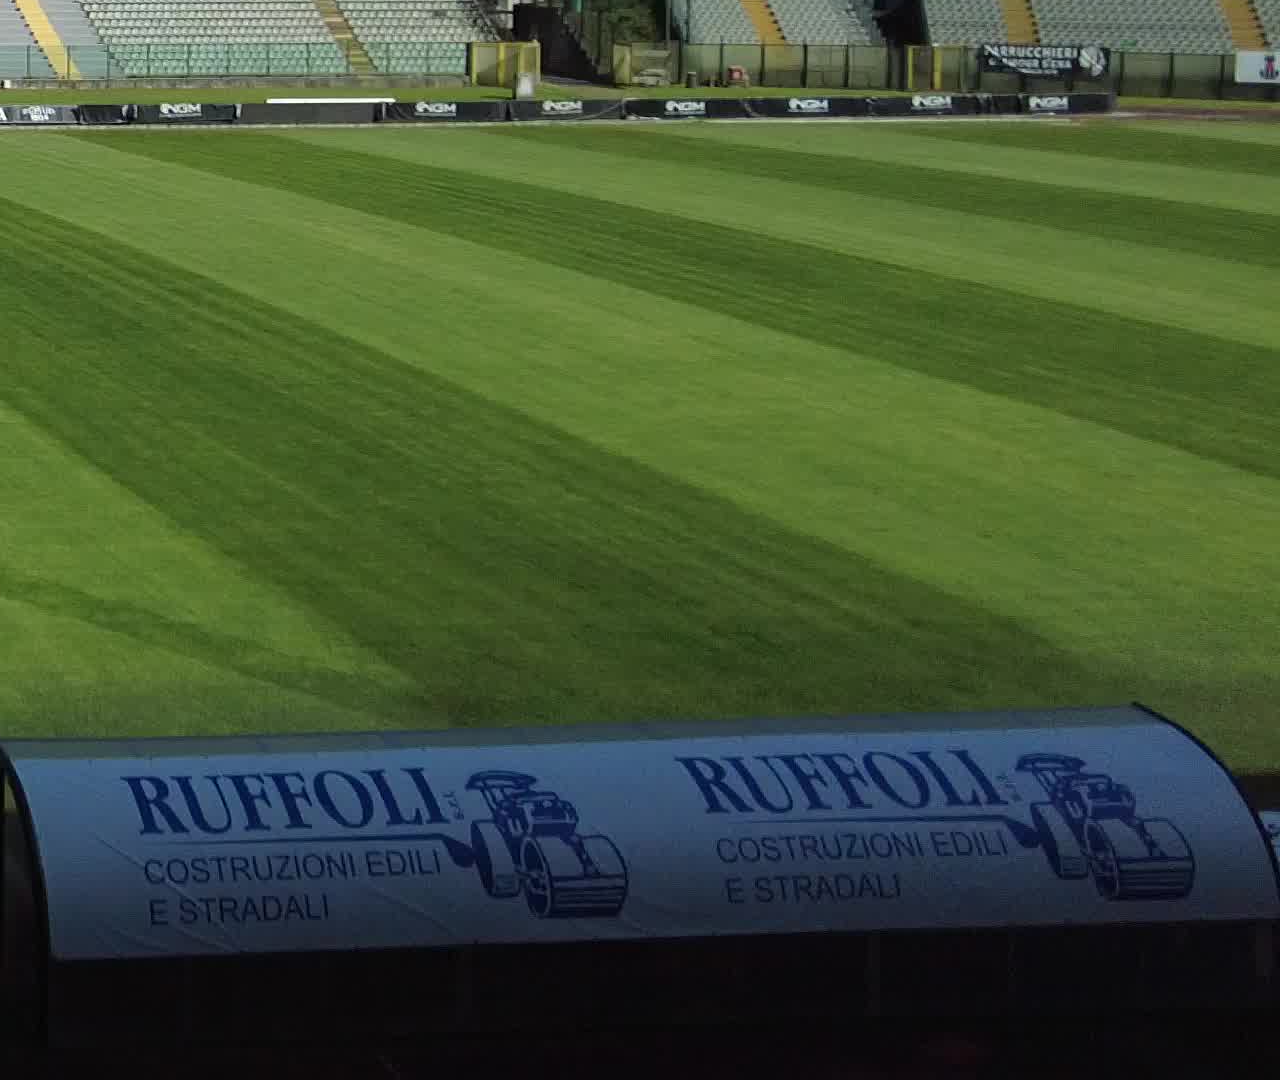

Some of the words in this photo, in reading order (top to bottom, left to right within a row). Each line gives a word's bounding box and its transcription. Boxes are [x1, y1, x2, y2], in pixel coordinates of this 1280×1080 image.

[680, 749, 1009, 815] RUFFOLI
[124, 767, 450, 836] RUFFOLI
[715, 832, 924, 864] COSTRUZIONI
[931, 828, 1009, 858] EDILI
[143, 853, 359, 886] COSTRUZIONI
[365, 848, 442, 878] EDILI
[725, 877, 745, 905] E
[754, 873, 902, 904] STRADALI
[149, 898, 169, 926] E
[178, 893, 330, 925] STRADALI
